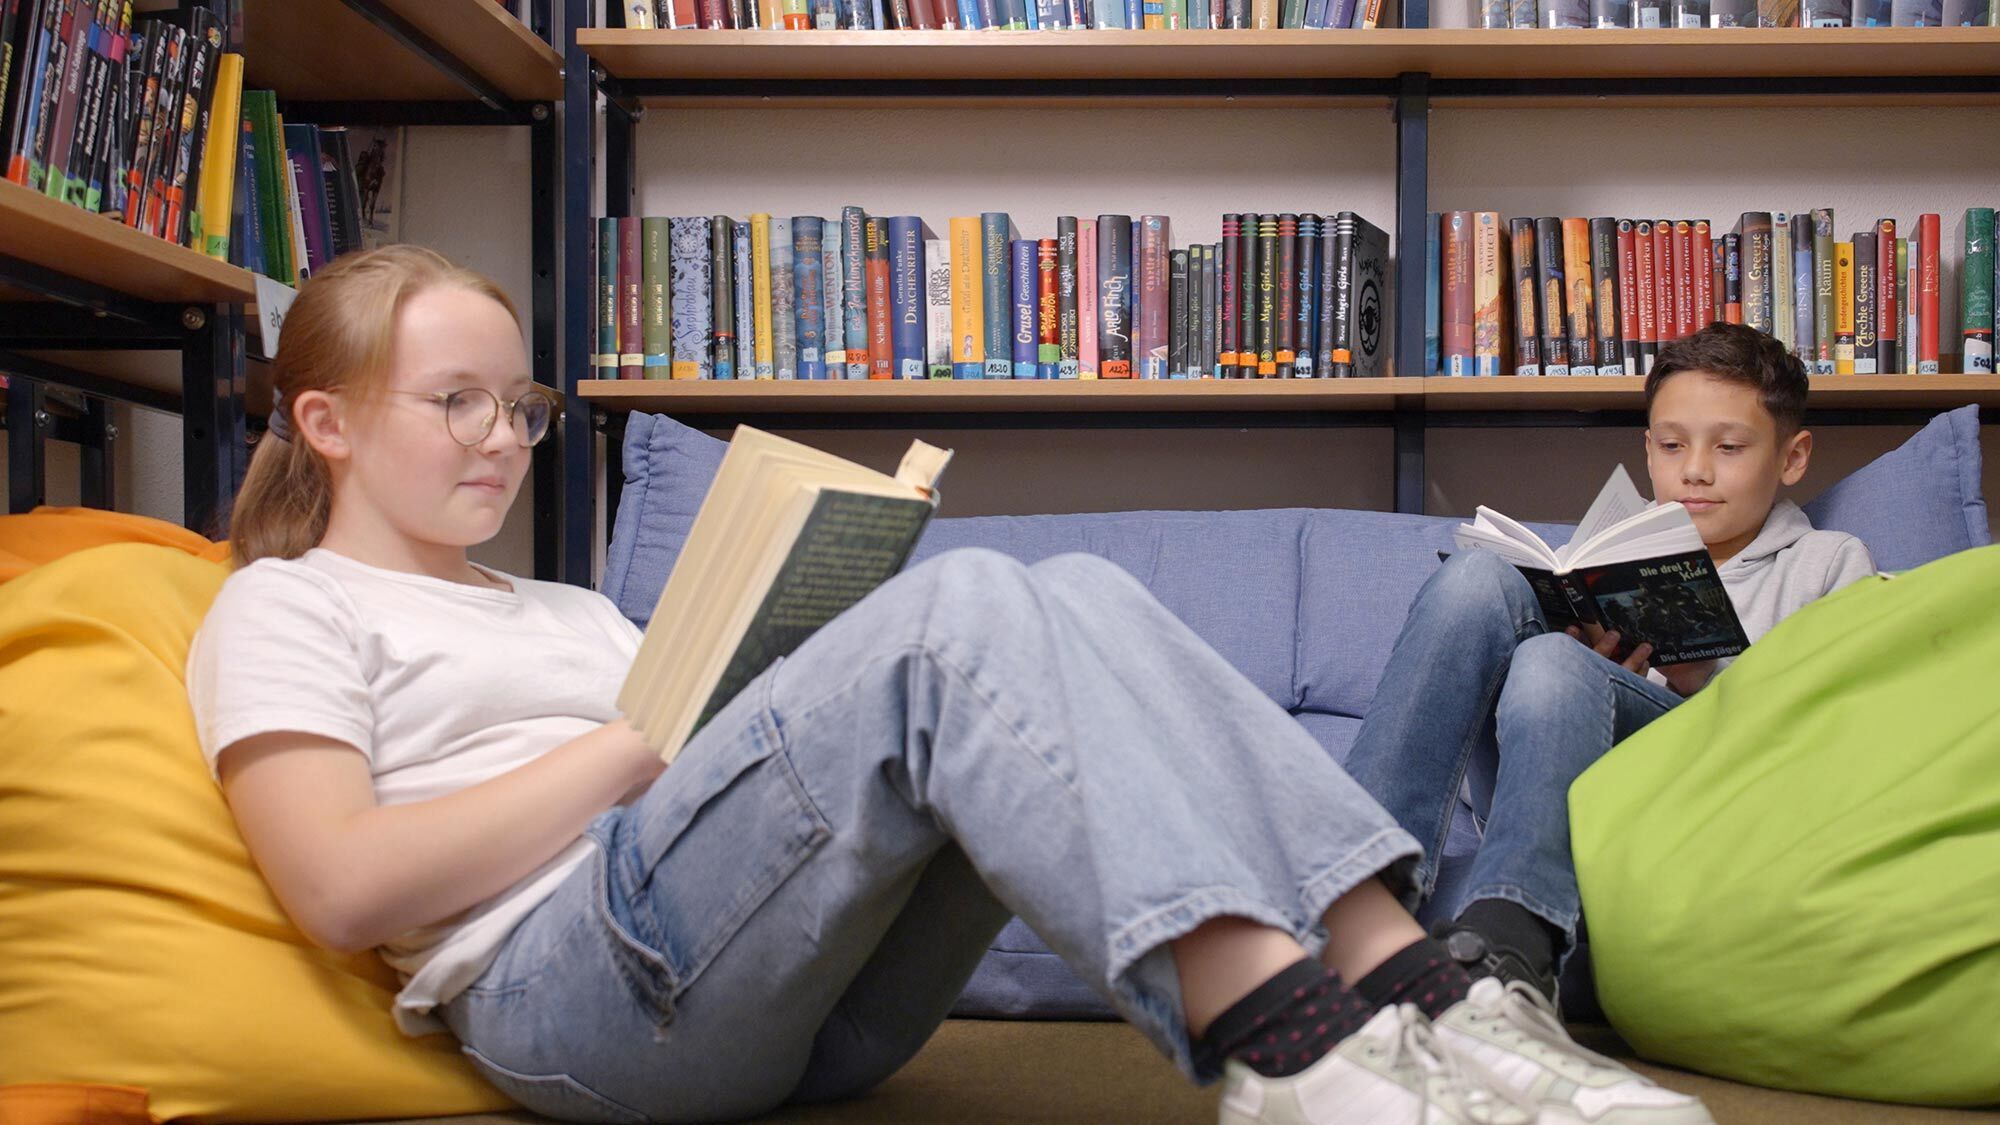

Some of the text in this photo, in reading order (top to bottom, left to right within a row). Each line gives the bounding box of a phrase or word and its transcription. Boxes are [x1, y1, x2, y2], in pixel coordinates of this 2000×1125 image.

[846, 213, 860, 291] Wunschpunsch
[869, 218, 878, 251] LUZIFER
[987, 224, 999, 275] SCHLANGEN
[1486, 226, 1495, 277] AMULETT
[1147, 256, 1155, 291] Charlie
[1448, 257, 1456, 292] Charlie
[1749, 233, 1761, 280] Greene
[825, 251, 835, 309] WENTON
[905, 230, 917, 324] DRACHENREITER
[930, 269, 940, 306] SHERLOCK
[940, 269, 950, 306] HOLMES
[1017, 246, 1032, 343] Grusel Geschichten
[1103, 274, 1128, 307] Finch
[1261, 268, 1272, 322] Magic Girls
[1299, 267, 1310, 322] Magic Girls
[1322, 267, 1334, 323] Magic Girls
[1336, 266, 1349, 320] Magic Girls
[1644, 241, 1653, 328] Mitternachtszirkus
[1819, 259, 1832, 296] Raum
[1047, 293, 1056, 328] STADION
[1223, 271, 1233, 321] Magic Girls
[1244, 295, 1254, 321] Magic
[1280, 294, 1291, 321] Magic
[1665, 286, 1673, 323] Prüfungen
[1702, 290, 1710, 309] Fürst
[1837, 272, 1848, 329] Bandengeschichten
[1855, 265, 1874, 347] Archie Greene
[1191, 314, 1199, 332] Magic
[1204, 306, 1212, 342] Magic Girls
[1639, 562, 1682, 577] Die drei
[1680, 567, 1708, 581] Kids
[1660, 646, 1742, 663] Die Geisterjäger
